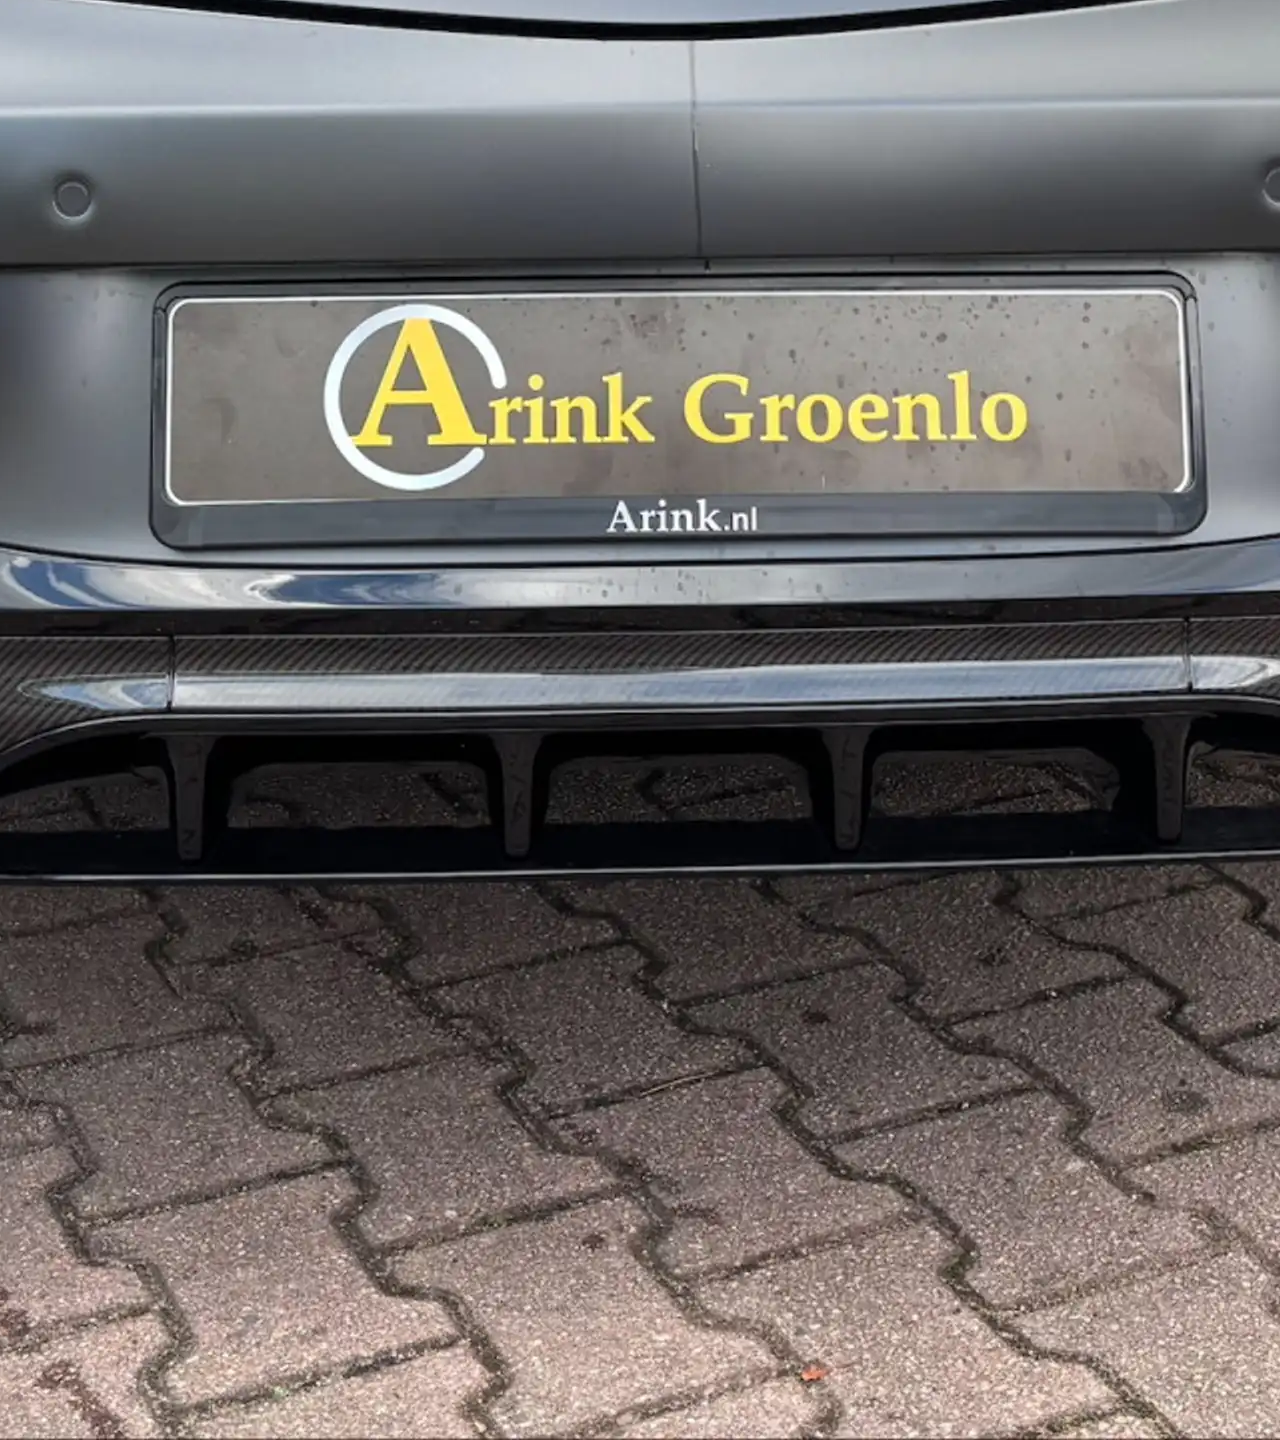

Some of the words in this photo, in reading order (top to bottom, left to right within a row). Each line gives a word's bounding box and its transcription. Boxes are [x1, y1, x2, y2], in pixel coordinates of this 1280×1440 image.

[348, 317, 656, 446] Arink
[684, 369, 1028, 444] Groenlo
[606, 498, 758, 533] Arink.nl
